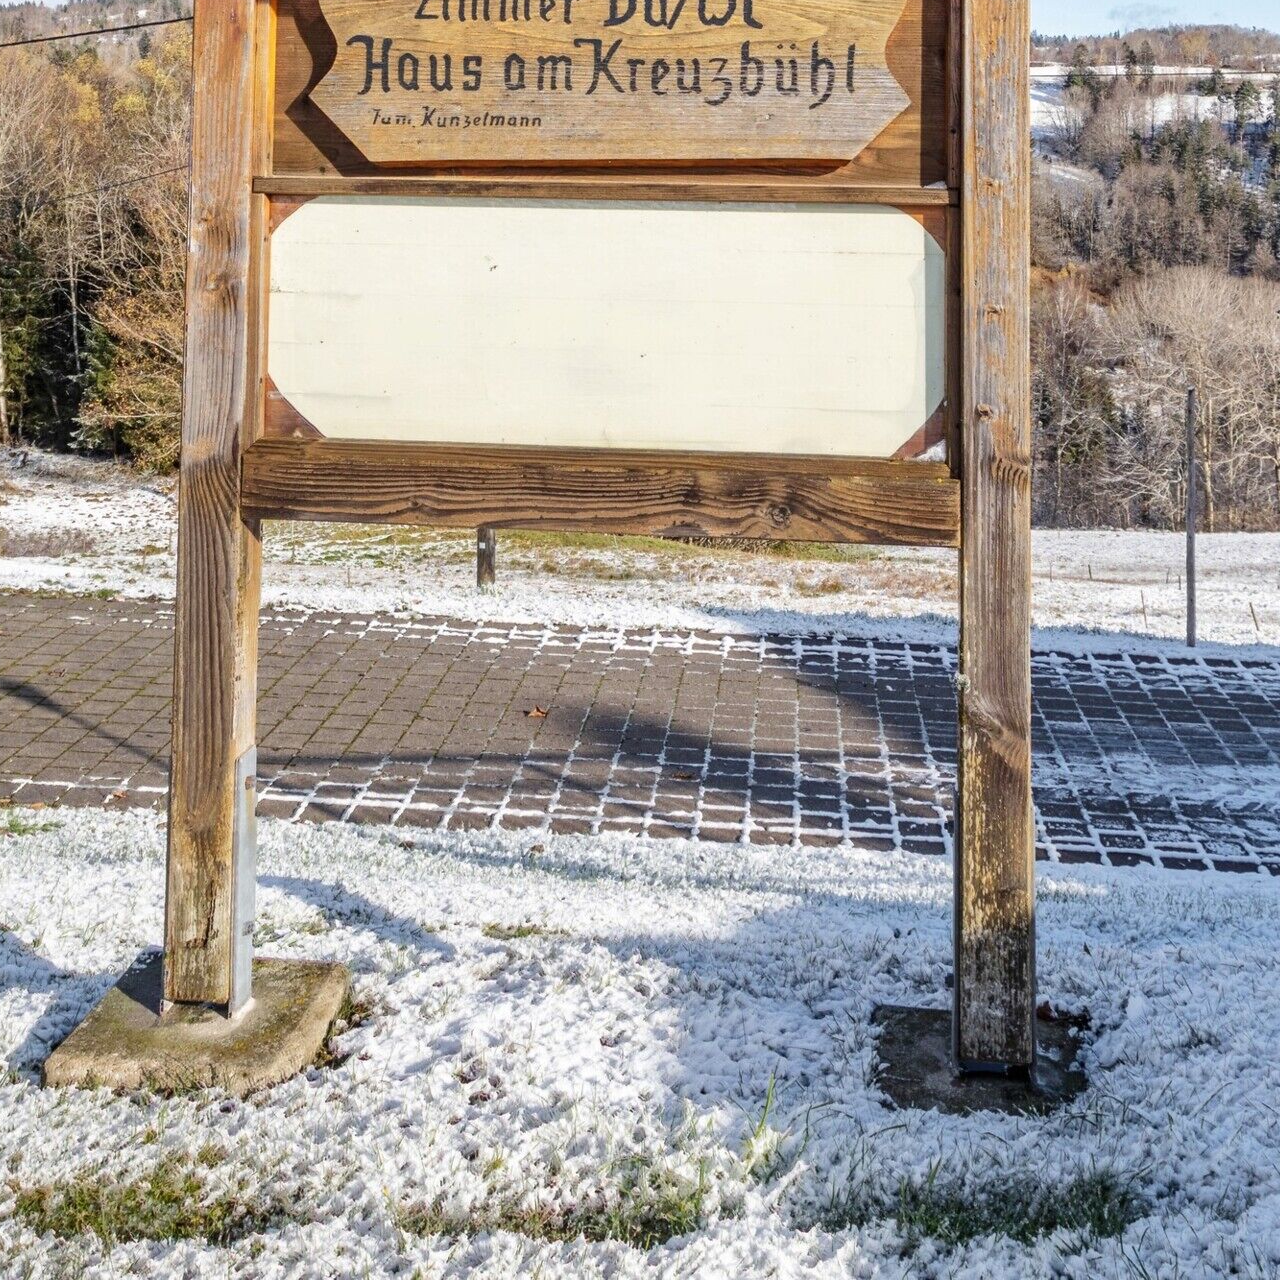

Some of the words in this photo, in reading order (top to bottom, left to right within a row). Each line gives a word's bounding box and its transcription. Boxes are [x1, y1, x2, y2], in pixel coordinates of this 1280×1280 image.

[346, 35, 482, 95] Haus
[503, 54, 573, 92] am
[573, 38, 856, 109] Kreuzbühl
[421, 106, 542, 129] Kunzelmann
